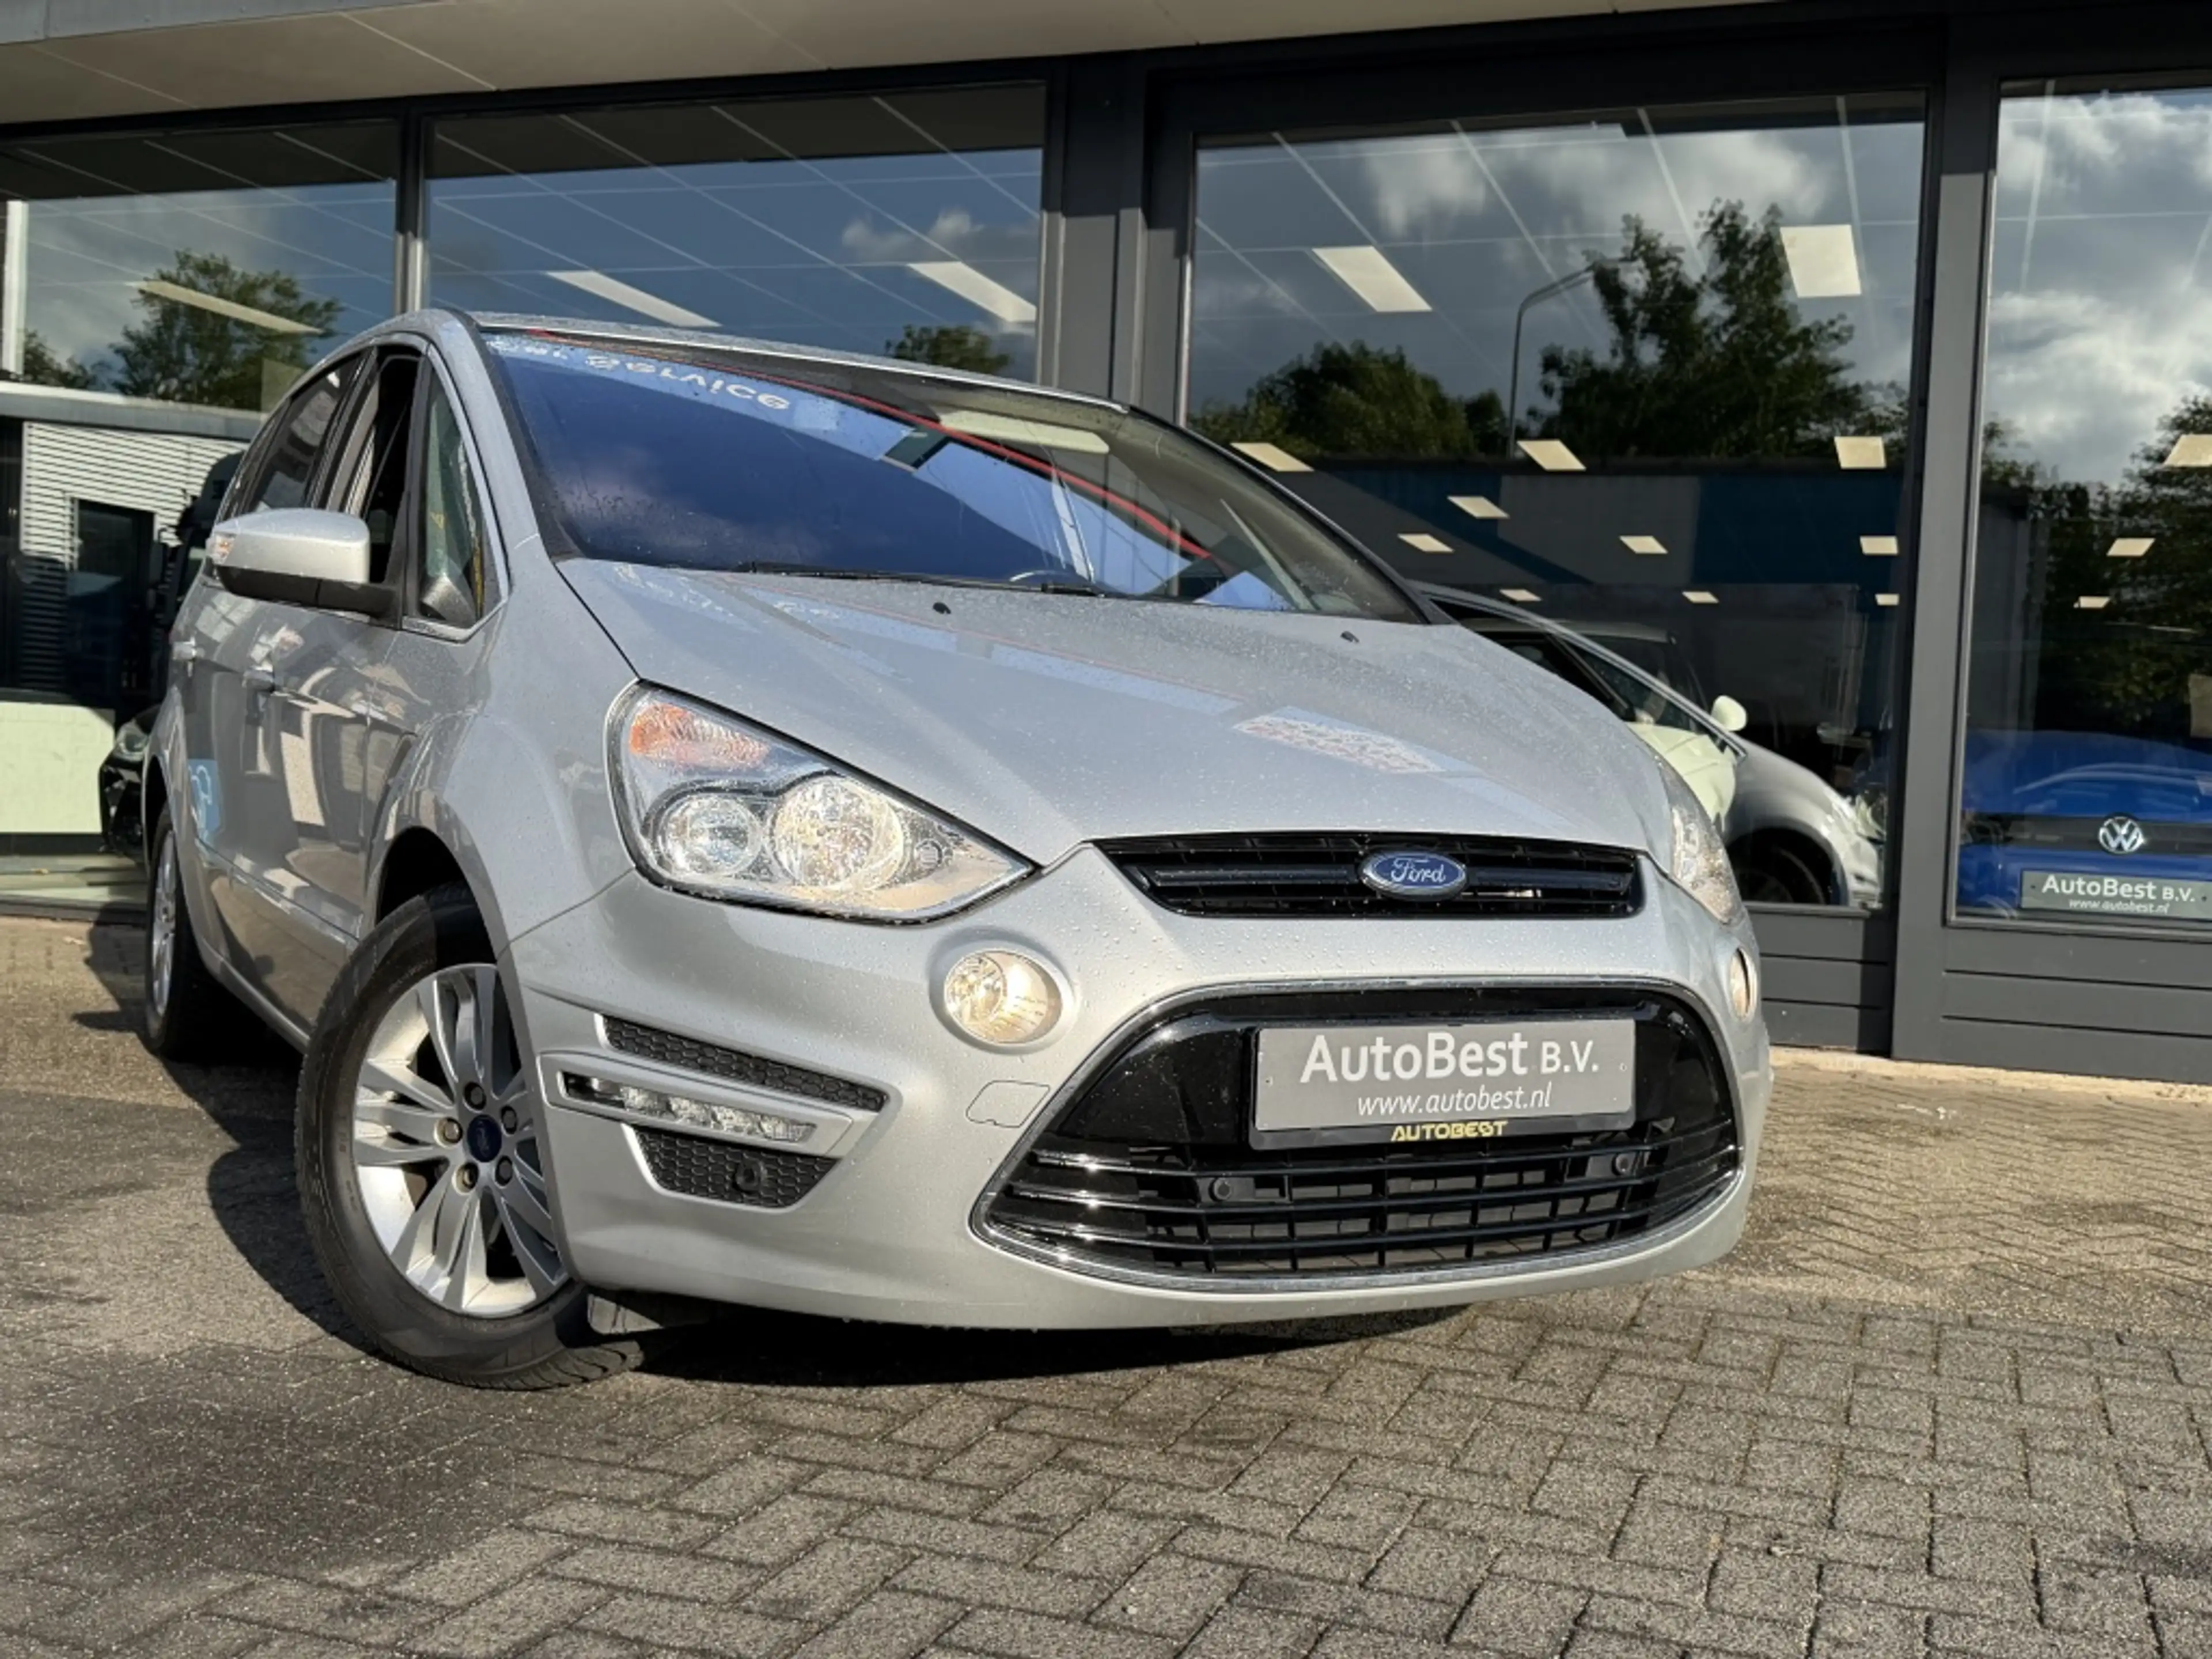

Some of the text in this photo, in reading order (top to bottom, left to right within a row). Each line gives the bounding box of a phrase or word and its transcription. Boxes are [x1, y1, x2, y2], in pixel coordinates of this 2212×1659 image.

[1391, 857, 1446, 882] Ford
[2041, 874, 2196, 902] AutoBest B.V.
[1300, 1031, 1600, 1084] AutoBest B.V.
[1357, 1080, 1552, 1116] www.autobest.nl
[1390, 1120, 1509, 1142] AUTOBEST
